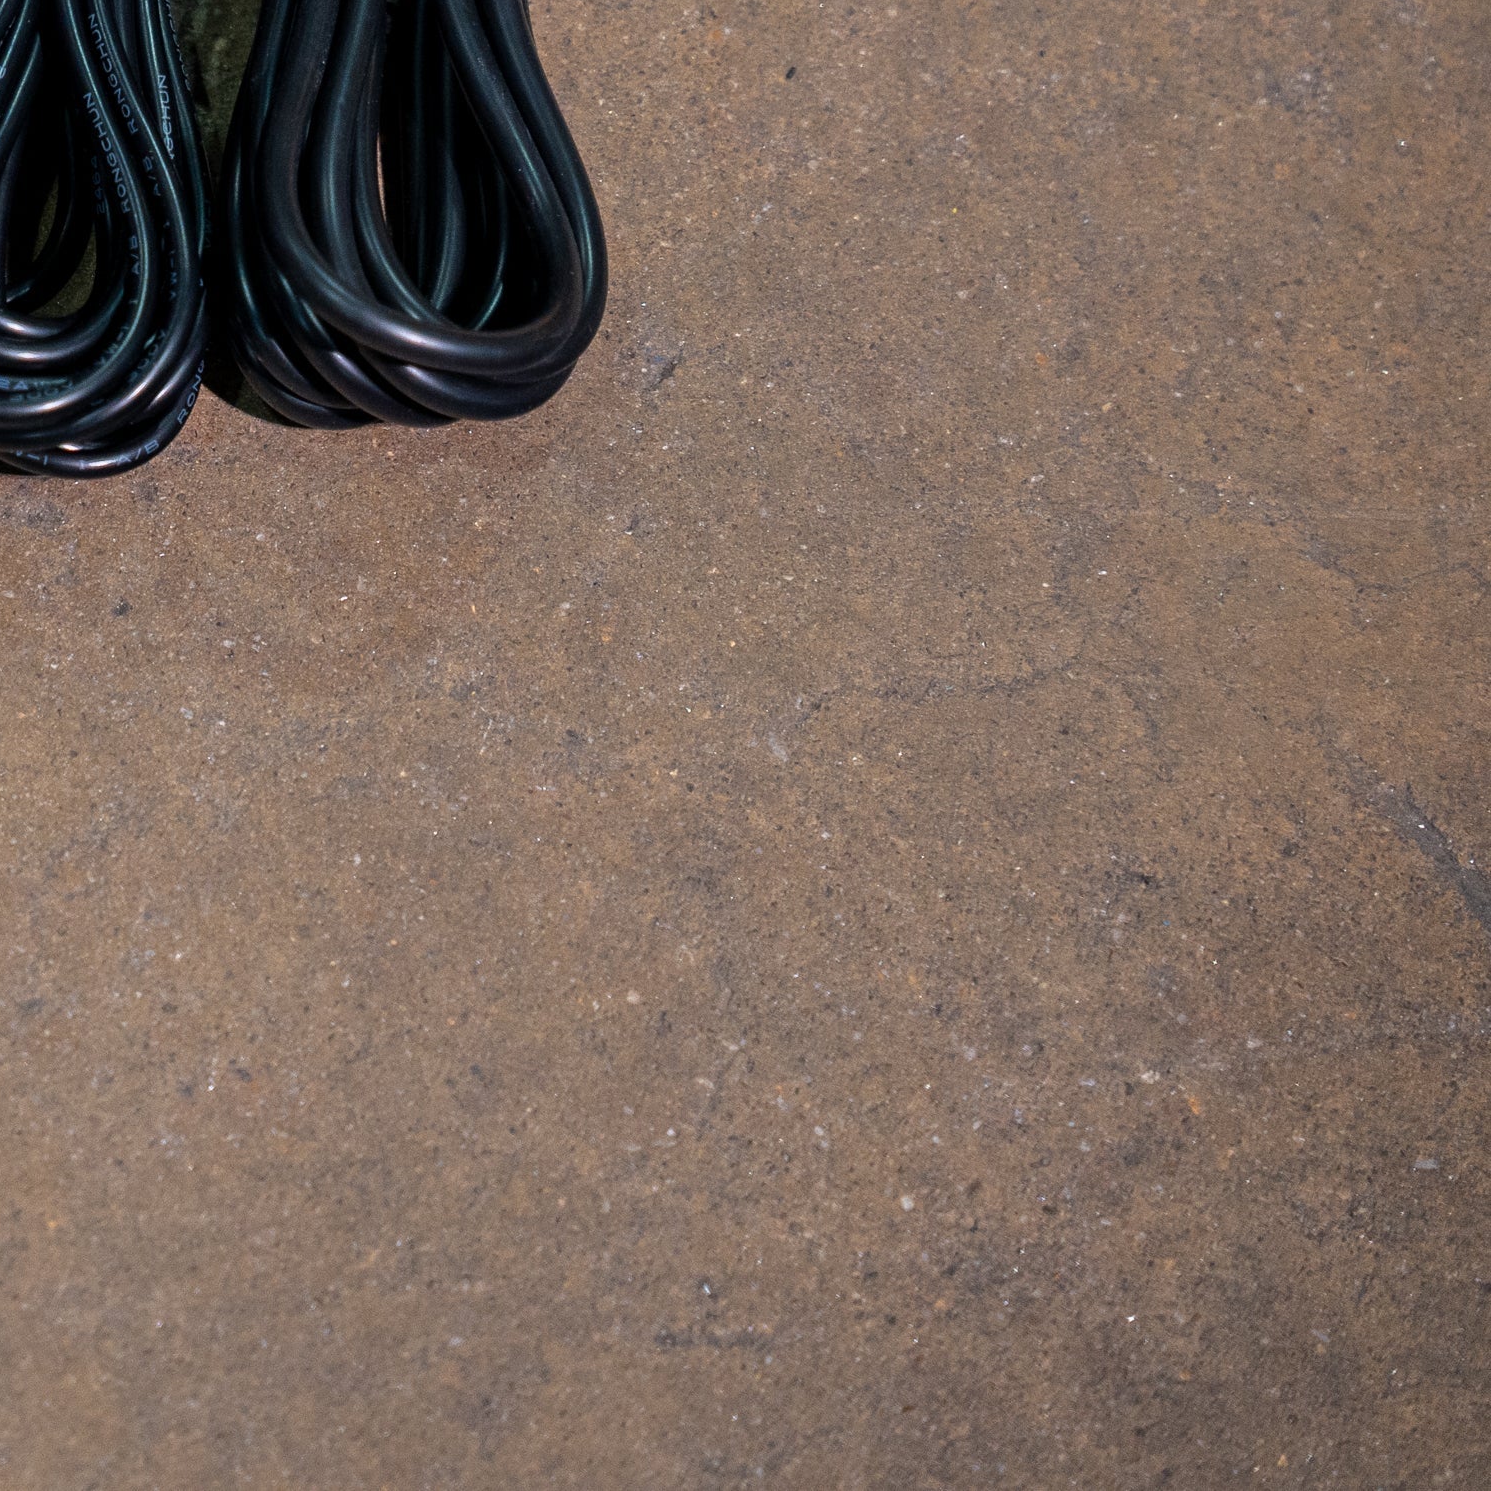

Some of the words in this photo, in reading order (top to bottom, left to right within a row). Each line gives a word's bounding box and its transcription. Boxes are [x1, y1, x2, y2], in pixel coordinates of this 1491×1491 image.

[88, 13, 139, 136] RONGCHUN
[83, 91, 132, 215] RONGCHUN
[142, 156, 162, 197] A/B
[117, 440, 160, 464] A/B
